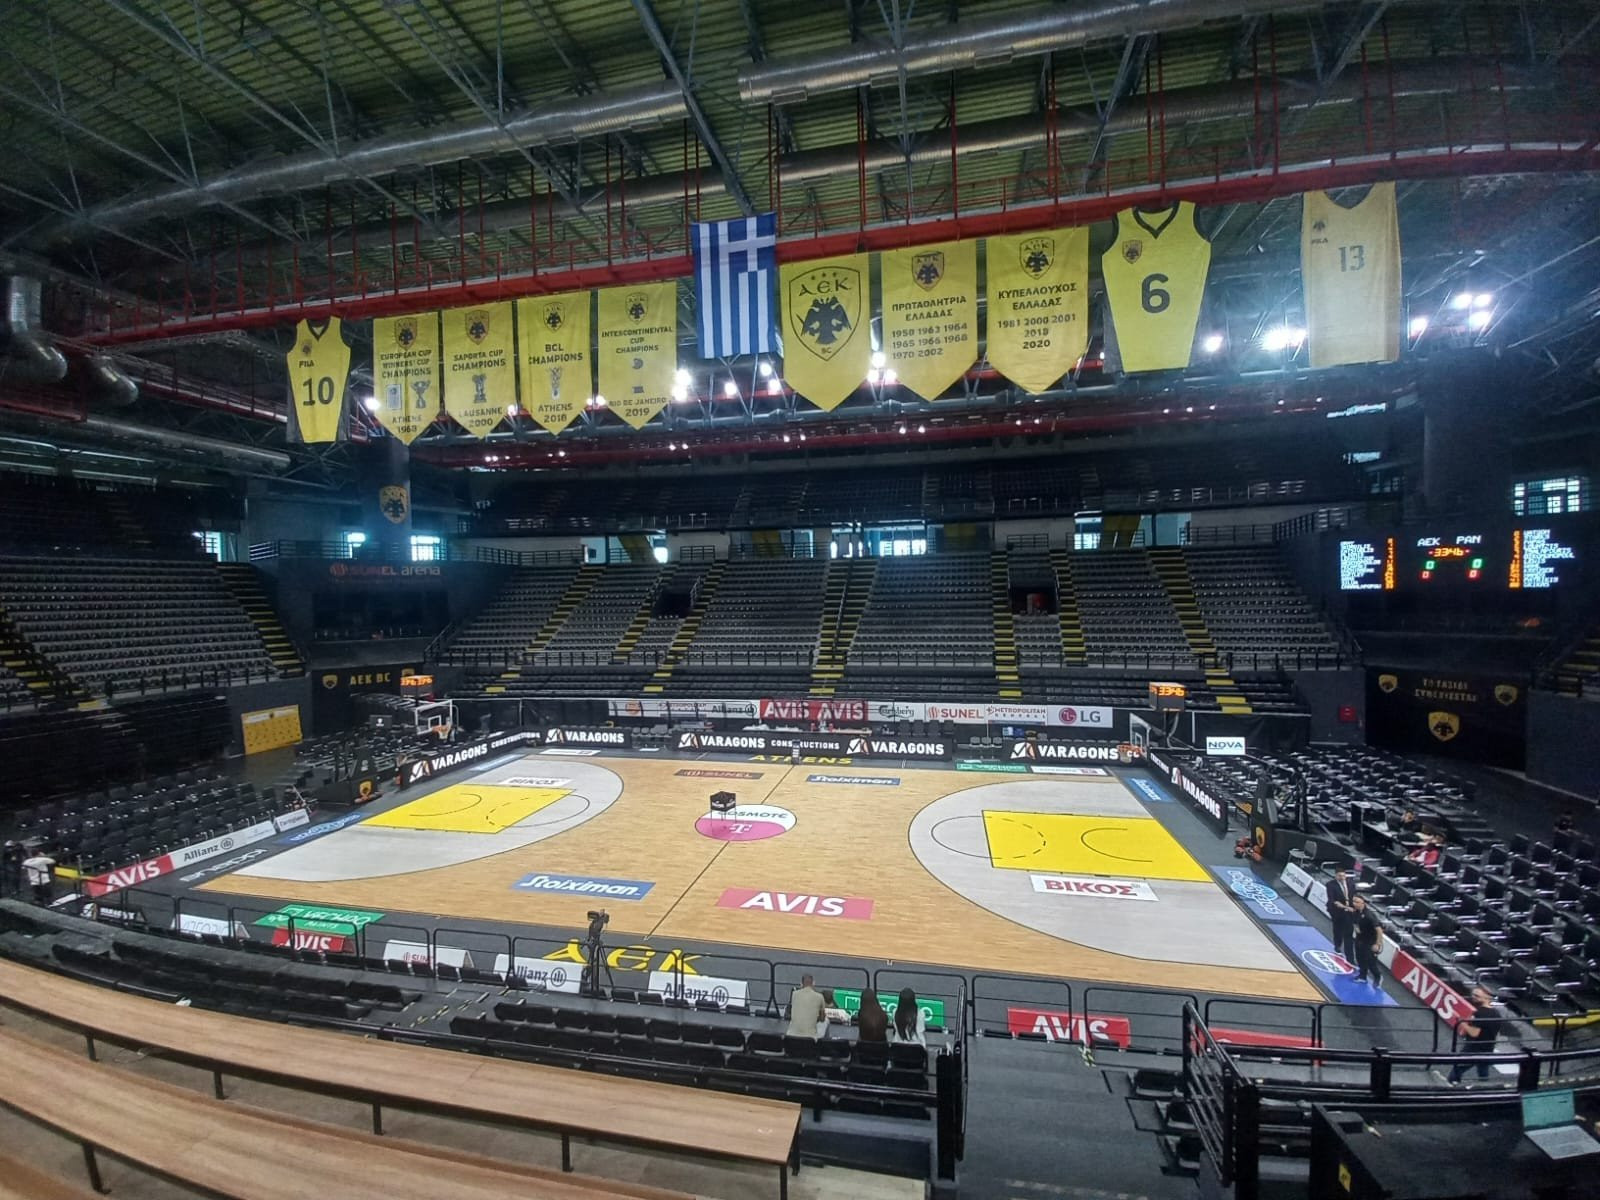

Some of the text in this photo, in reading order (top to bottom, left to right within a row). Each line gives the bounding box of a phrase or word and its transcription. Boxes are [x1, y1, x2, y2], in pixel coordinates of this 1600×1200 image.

[1338, 245, 1365, 272] 13
[1141, 273, 1171, 314] 6
[1012, 297, 1062, 311] ΕΛΛΑΔΑΣ
[905, 309, 953, 322] ΕΛΛΑΔΑΣ
[997, 313, 1076, 329] 1981 2000 2001
[601, 326, 674, 338] INTERCONTINENTAL
[918, 326, 940, 336] 1963
[944, 323, 967, 333] 1964
[1024, 327, 1048, 337] 2018
[630, 337, 644, 345] CUP
[892, 334, 968, 349] 1965 1966 1968
[1022, 339, 1051, 349] 2020
[545, 344, 564, 353] BCL
[615, 345, 659, 354] CHAMPIONS
[892, 348, 943, 360] 1970 2002
[380, 349, 432, 361] EUROPEAN CUP
[453, 349, 504, 361] SAPORTA CUP
[528, 353, 583, 365] CHAMPIONS
[298, 360, 315, 368] FILA
[416, 358, 430, 366] CUP
[452, 358, 506, 372] CHAMPIONS
[382, 367, 432, 379] CHAMPIONS
[302, 376, 335, 406] 10
[634, 397, 667, 406] JANEIRO
[459, 406, 503, 418] LAUSANNE
[538, 403, 573, 413] ATHENS
[625, 407, 650, 417] 2019
[468, 417, 493, 428] 2000
[543, 414, 567, 424] 2018
[1456, 535, 1482, 545] PAN
[1425, 558, 1482, 570] 0 0
[401, 566, 441, 576] arena
[350, 674, 372, 685] AEK
[764, 702, 864, 720] AVIS AVIS
[941, 708, 984, 719] SUNEL
[994, 706, 1046, 714] METROPOLITAN
[1080, 711, 1101, 724] LG
[565, 731, 625, 743] VARAGONS
[701, 736, 765, 749] VARAGONS
[871, 741, 945, 755] VARAGONS
[1208, 741, 1243, 749] NOVA
[432, 744, 488, 771] VARAGONS
[1038, 744, 1119, 760] VARAGONS
[1182, 775, 1222, 819] VARAGONS
[183, 844, 219, 862] Allianz
[106, 860, 161, 892] AVIS
[520, 876, 638, 895] Stoiximan
[740, 892, 846, 917] AVIS
[1401, 966, 1459, 1019] AVIS
[1032, 1015, 1110, 1046] AVIS
